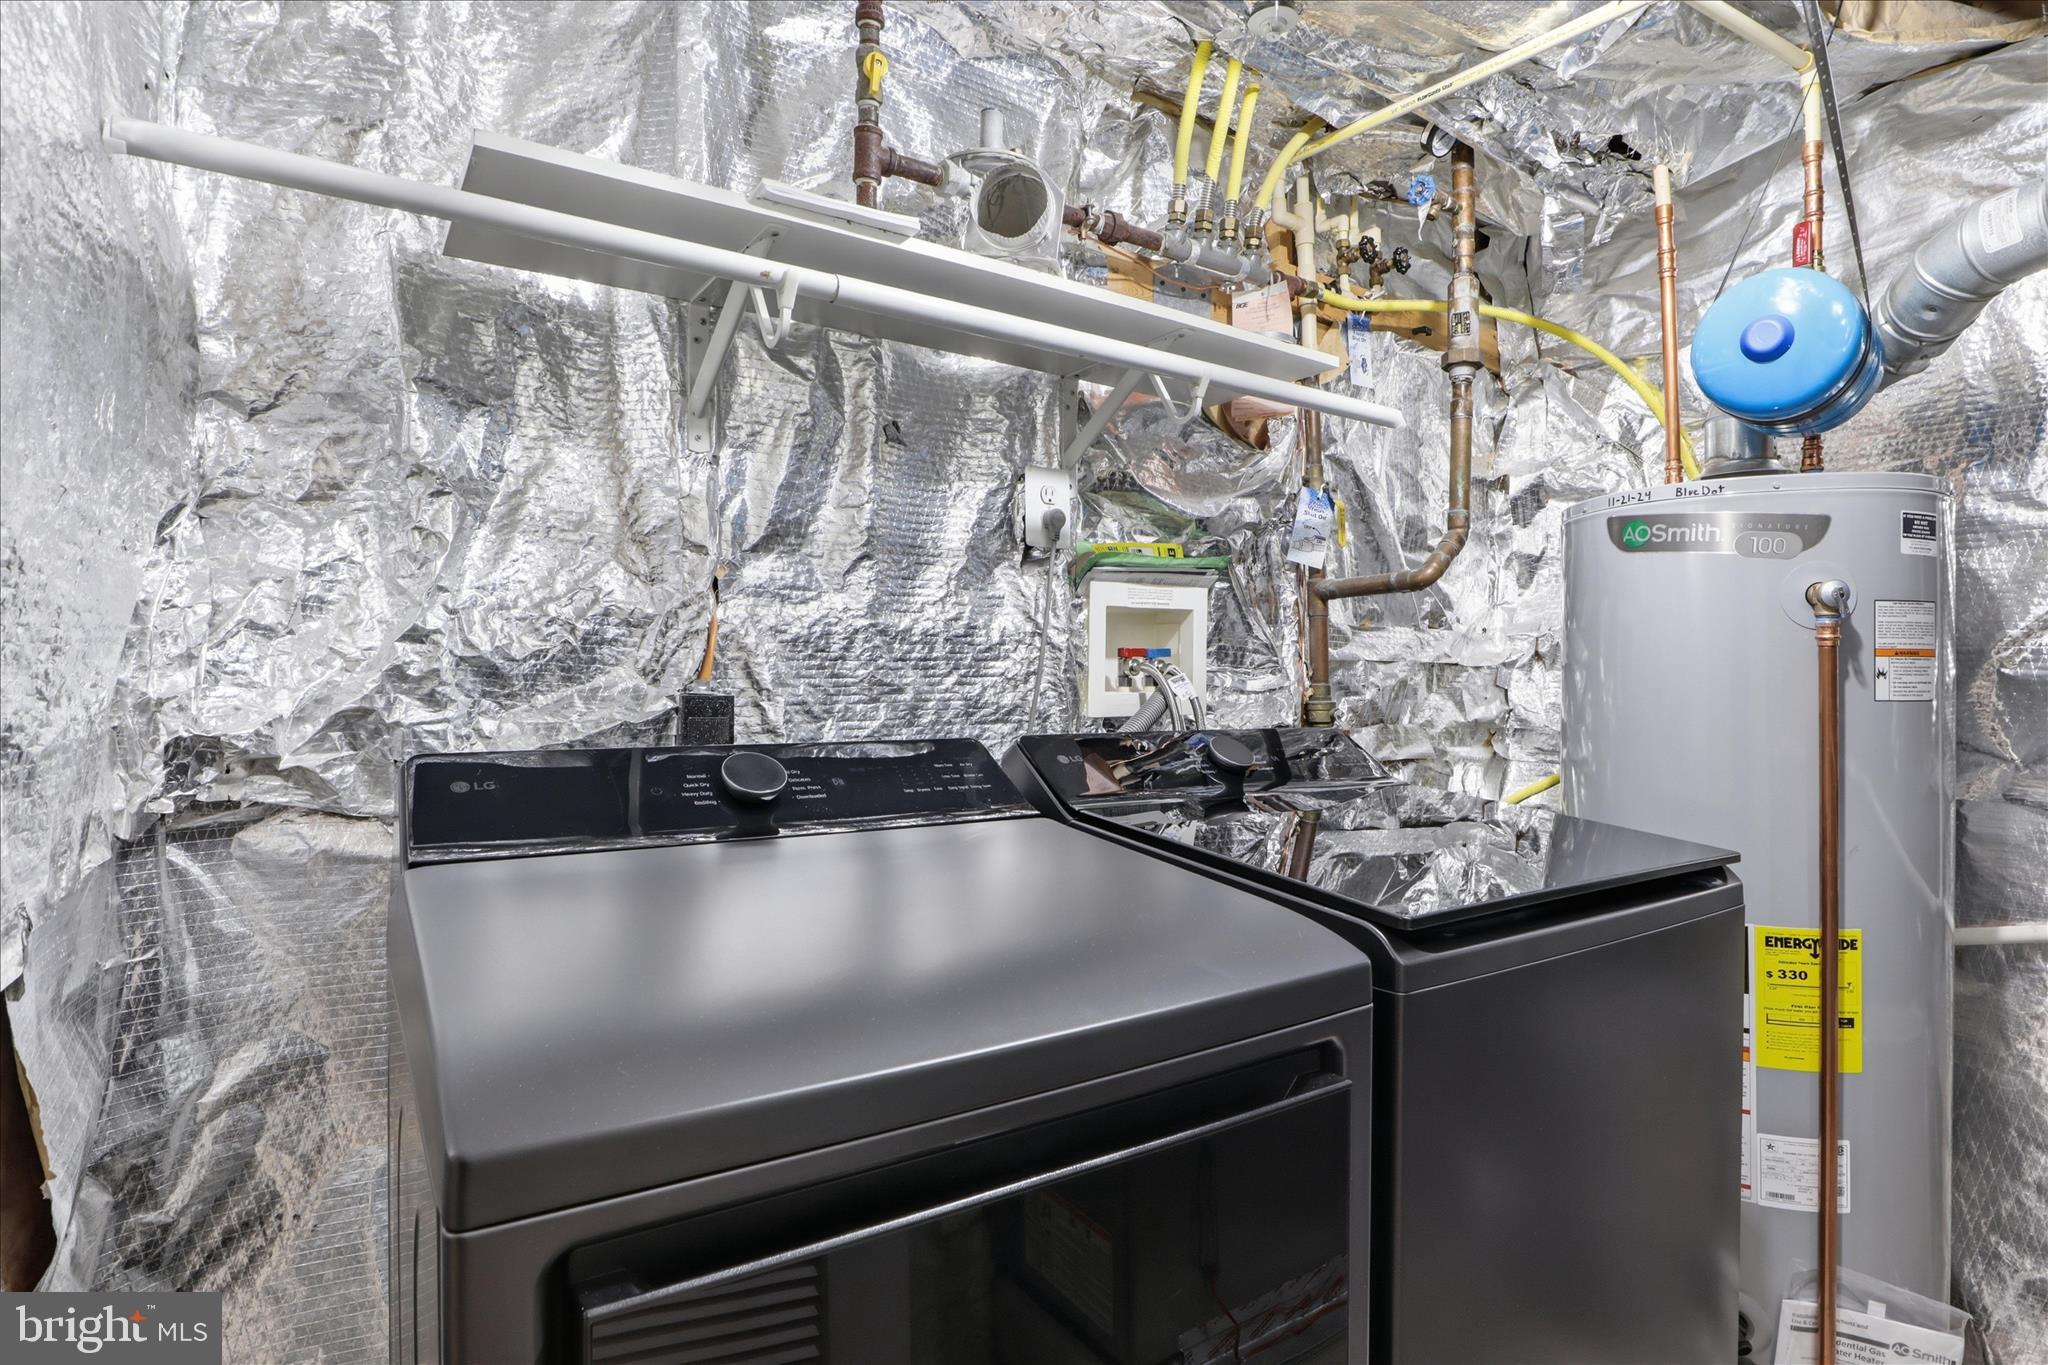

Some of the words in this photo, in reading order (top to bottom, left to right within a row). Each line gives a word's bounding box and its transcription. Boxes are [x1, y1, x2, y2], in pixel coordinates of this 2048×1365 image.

[1607, 491, 1651, 507] 11-21-24
[1704, 485, 1726, 496] Dot
[1750, 536, 1786, 554] 100
[474, 781, 496, 790] LG
[1778, 969, 1808, 980] 330
[1869, 1347, 1886, 1358] Gas
[1911, 1349, 1951, 1364] Smith
[1854, 1353, 1885, 1365] Heater
